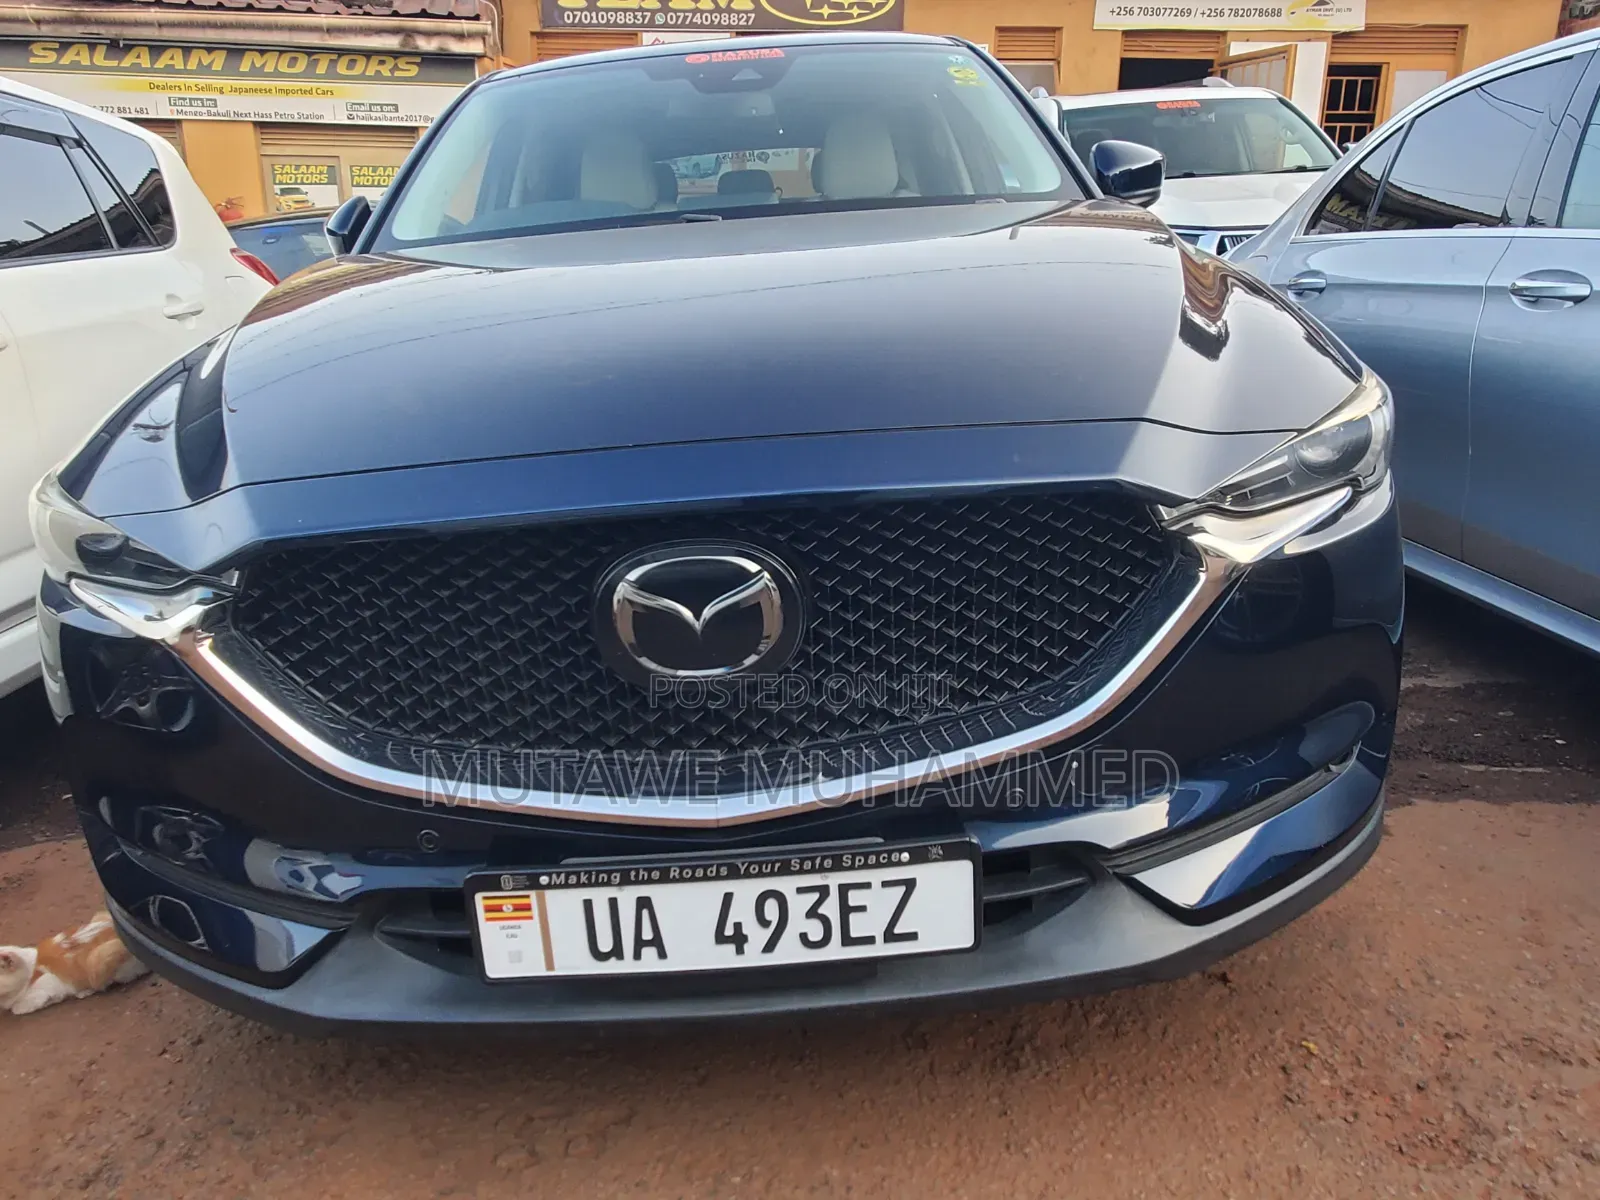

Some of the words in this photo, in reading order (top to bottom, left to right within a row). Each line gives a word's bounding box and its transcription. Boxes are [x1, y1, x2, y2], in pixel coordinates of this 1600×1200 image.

[1109, 7, 1135, 17] +256
[1137, 7, 1192, 18] 703077269
[1193, 7, 1199, 18] /
[1200, 8, 1225, 18] +256
[1227, 8, 1283, 18] 782078688
[564, 11, 651, 24] 0701098837
[667, 12, 756, 26] 0774098827
[28, 42, 228, 71] SALAAM
[239, 51, 422, 77] MOTORS
[148, 82, 182, 92] Dealers
[184, 83, 193, 92] In
[194, 84, 225, 95] Selling
[228, 85, 273, 95] Japaneese
[275, 86, 313, 96] Imported
[315, 87, 334, 96] Cars
[170, 97, 190, 106] Find
[191, 99, 202, 107] us
[347, 102, 370, 112] Email
[371, 104, 381, 112] us
[117, 106, 132, 114] 881
[134, 107, 150, 115] 481
[233, 110, 252, 118] Next
[253, 111, 273, 119] Hass
[274, 111, 295, 120] Petro
[297, 111, 325, 120] Station
[273, 165, 328, 174] SALAAM
[275, 174, 329, 184] MOTORS
[551, 872, 621, 886] Making
[630, 868, 660, 882] the
[669, 864, 728, 880] Roads
[738, 861, 780, 875] Your
[790, 856, 833, 871] Safe
[842, 852, 899, 868] Space
[582, 895, 668, 962] UA
[714, 877, 919, 956] 493EZ
